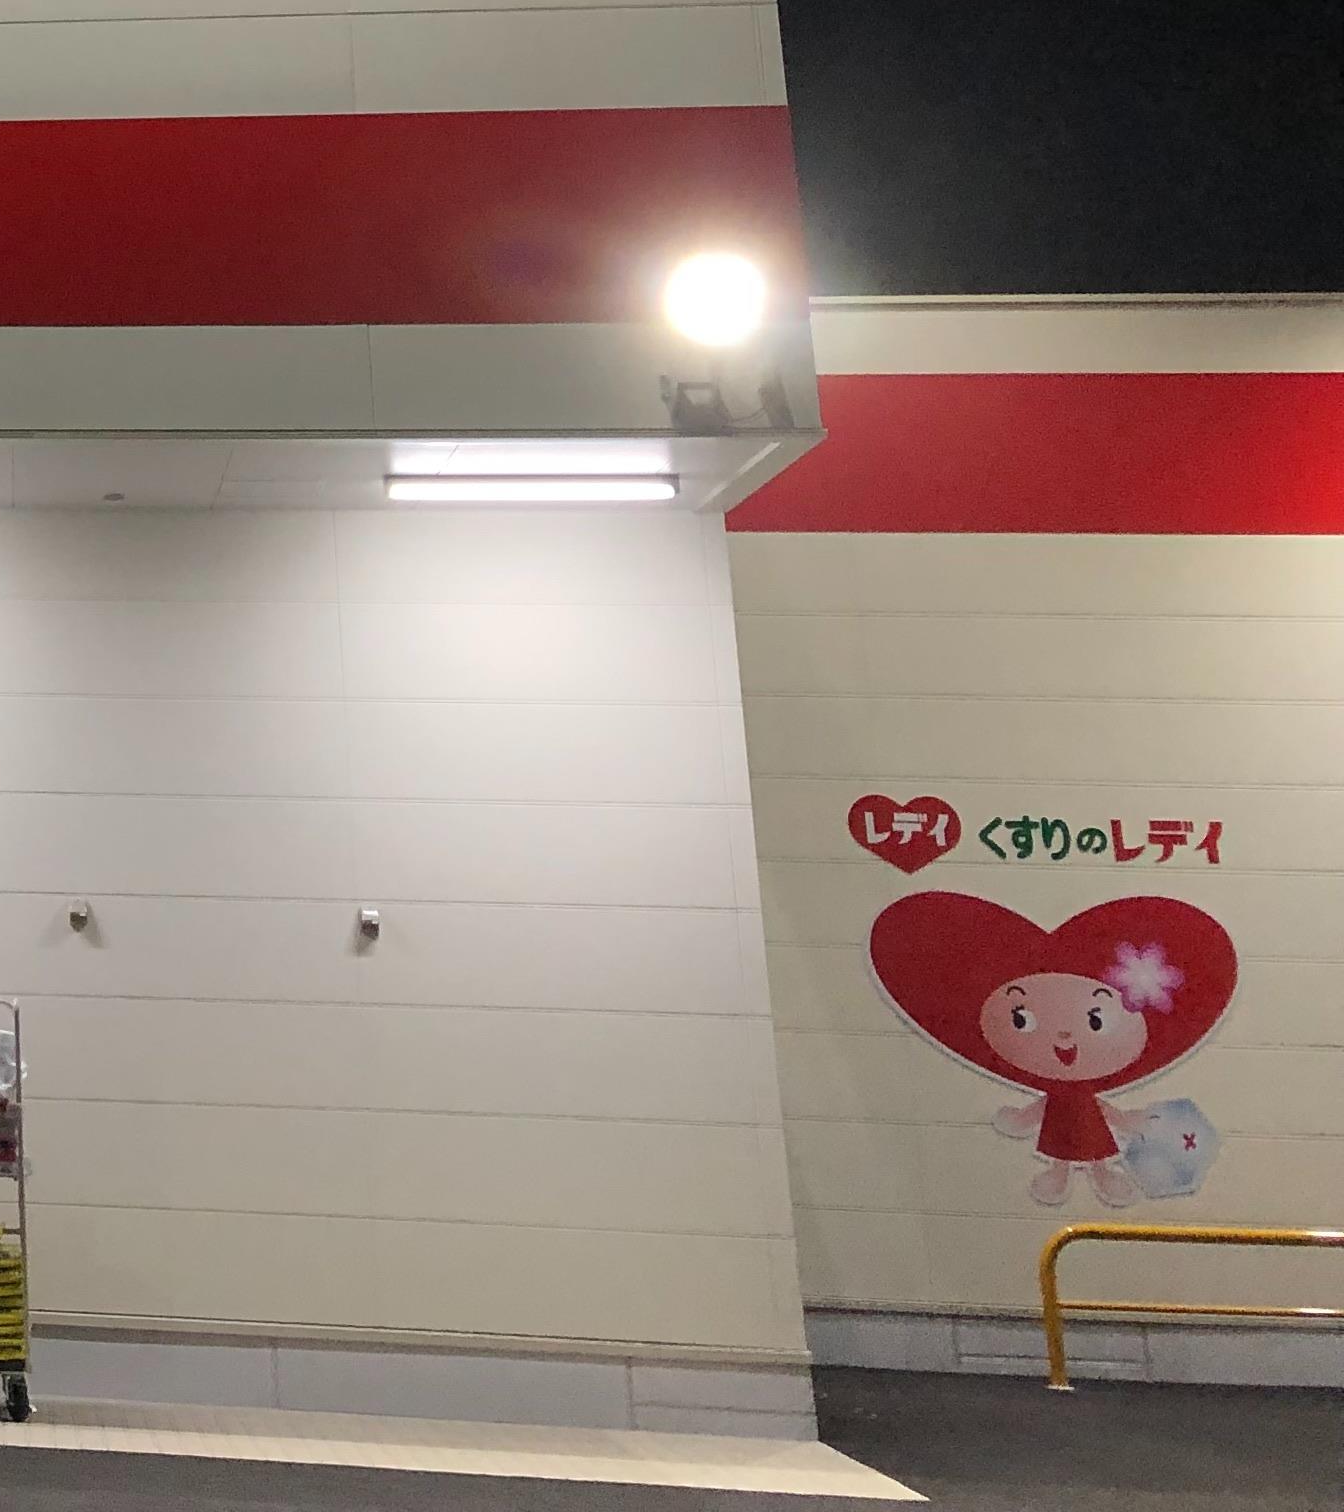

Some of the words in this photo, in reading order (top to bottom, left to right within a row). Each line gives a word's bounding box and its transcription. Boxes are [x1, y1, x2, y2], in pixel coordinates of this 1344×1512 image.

[864, 811, 951, 847] レディ
[978, 817, 1224, 865] くすりのレディ
